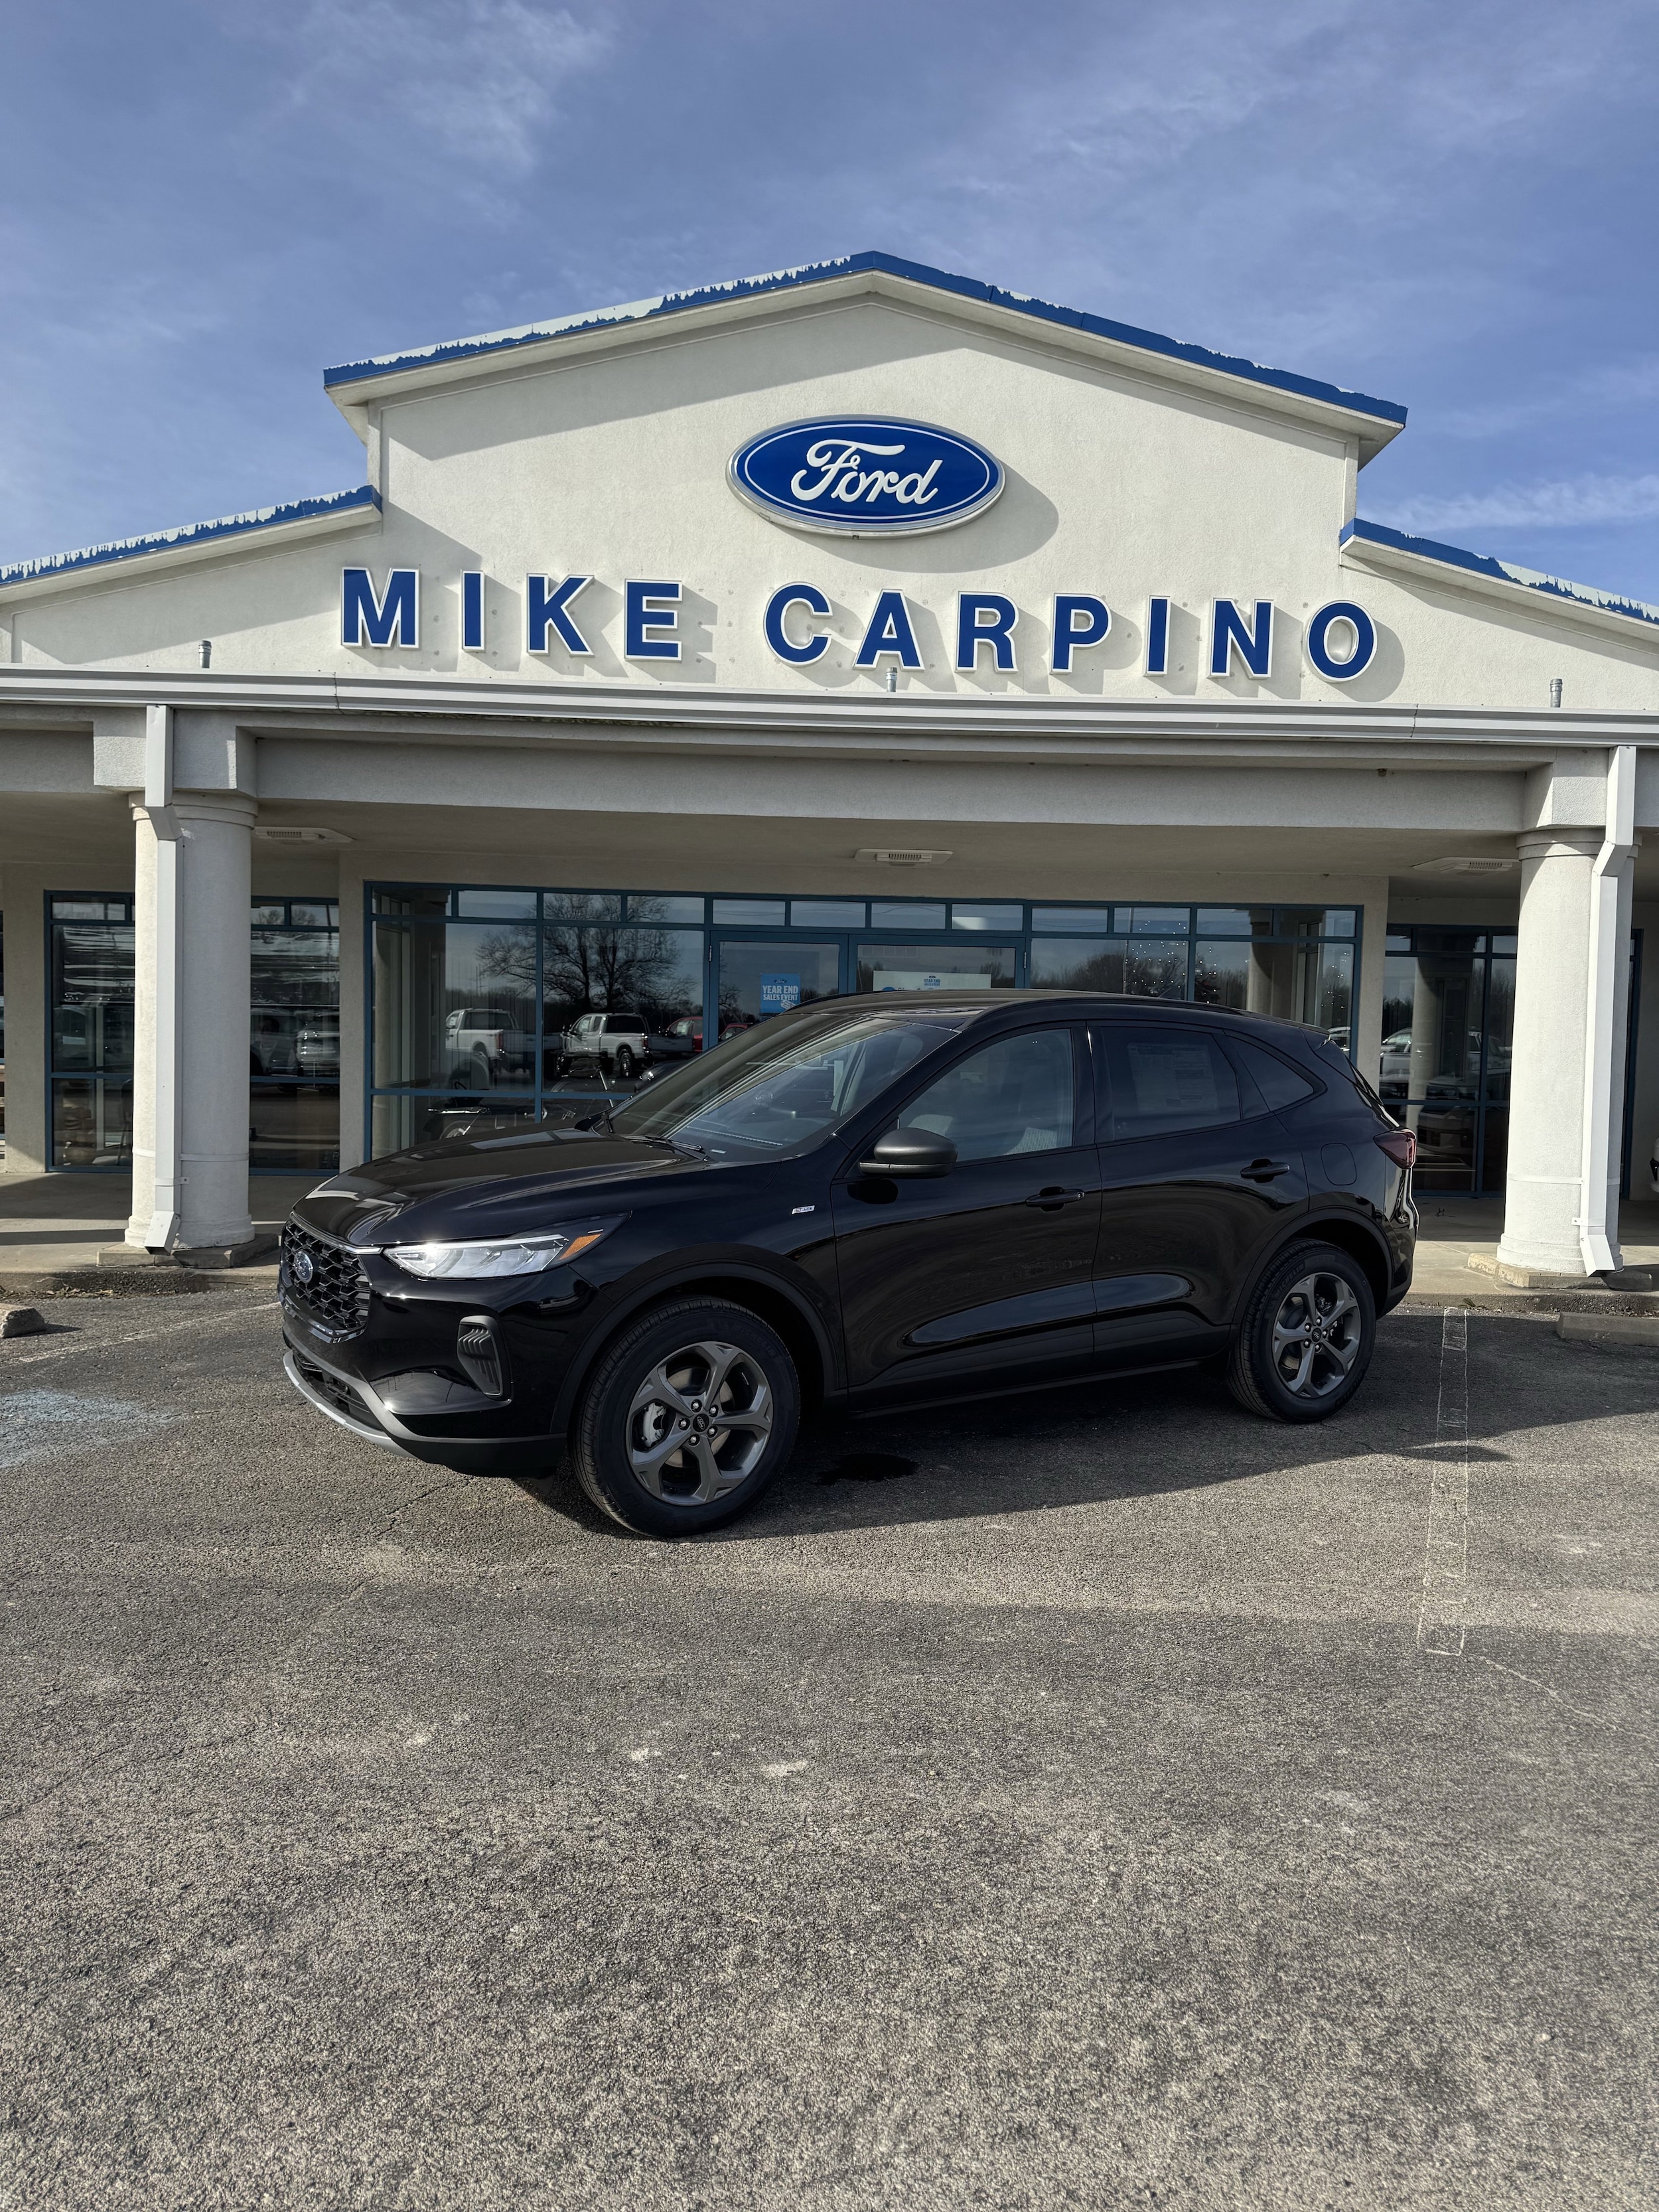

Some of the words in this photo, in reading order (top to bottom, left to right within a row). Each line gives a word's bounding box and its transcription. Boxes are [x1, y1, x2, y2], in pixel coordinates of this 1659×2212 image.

[791, 439, 943, 505] Ford
[340, 567, 683, 661] MIKE
[763, 581, 1377, 683] CARPINO
[762, 986, 782, 994] YEAR
[783, 986, 799, 994] END
[1275, 1261, 1305, 1299] MICHELIN
